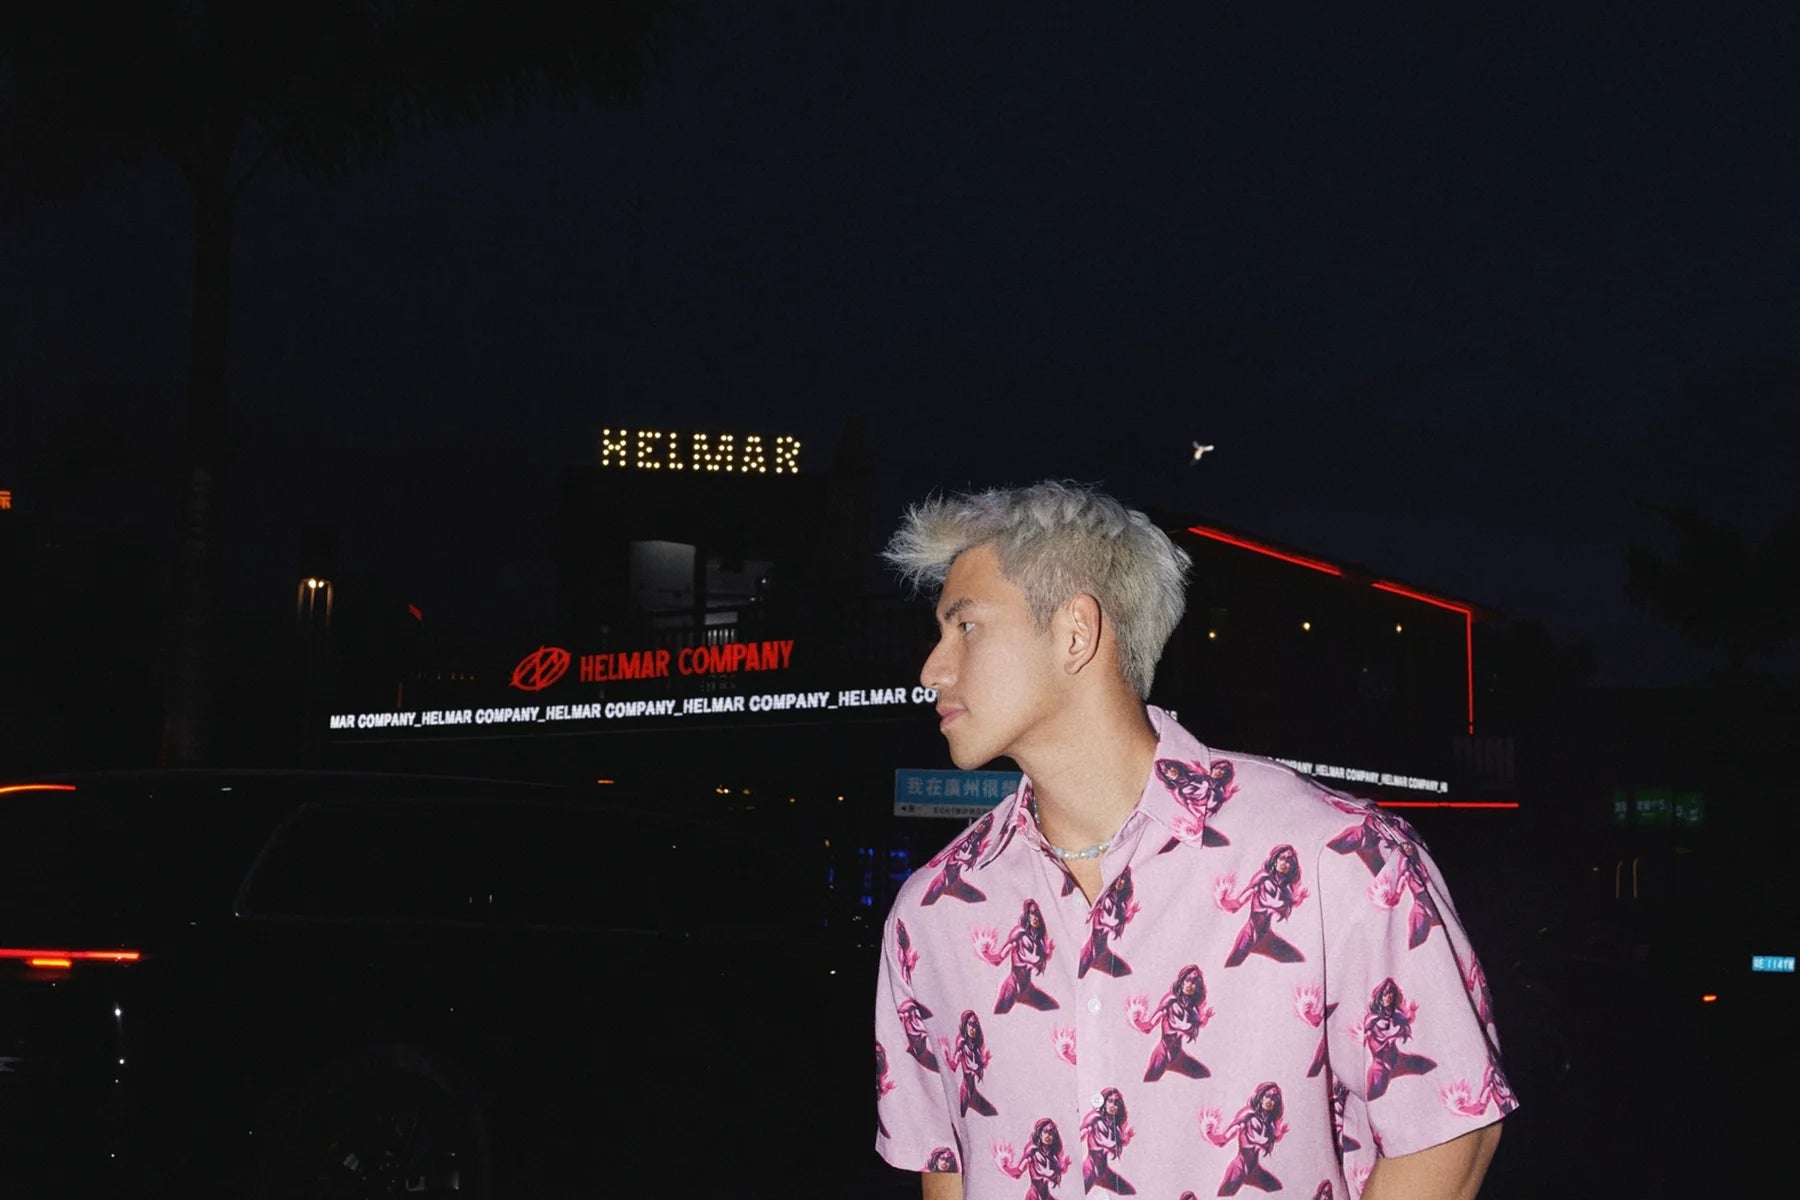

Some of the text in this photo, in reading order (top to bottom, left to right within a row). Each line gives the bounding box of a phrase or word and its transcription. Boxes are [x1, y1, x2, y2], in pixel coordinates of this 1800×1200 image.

[602, 428, 800, 473] HELMAR
[579, 640, 794, 682] HELMAR COMPANY
